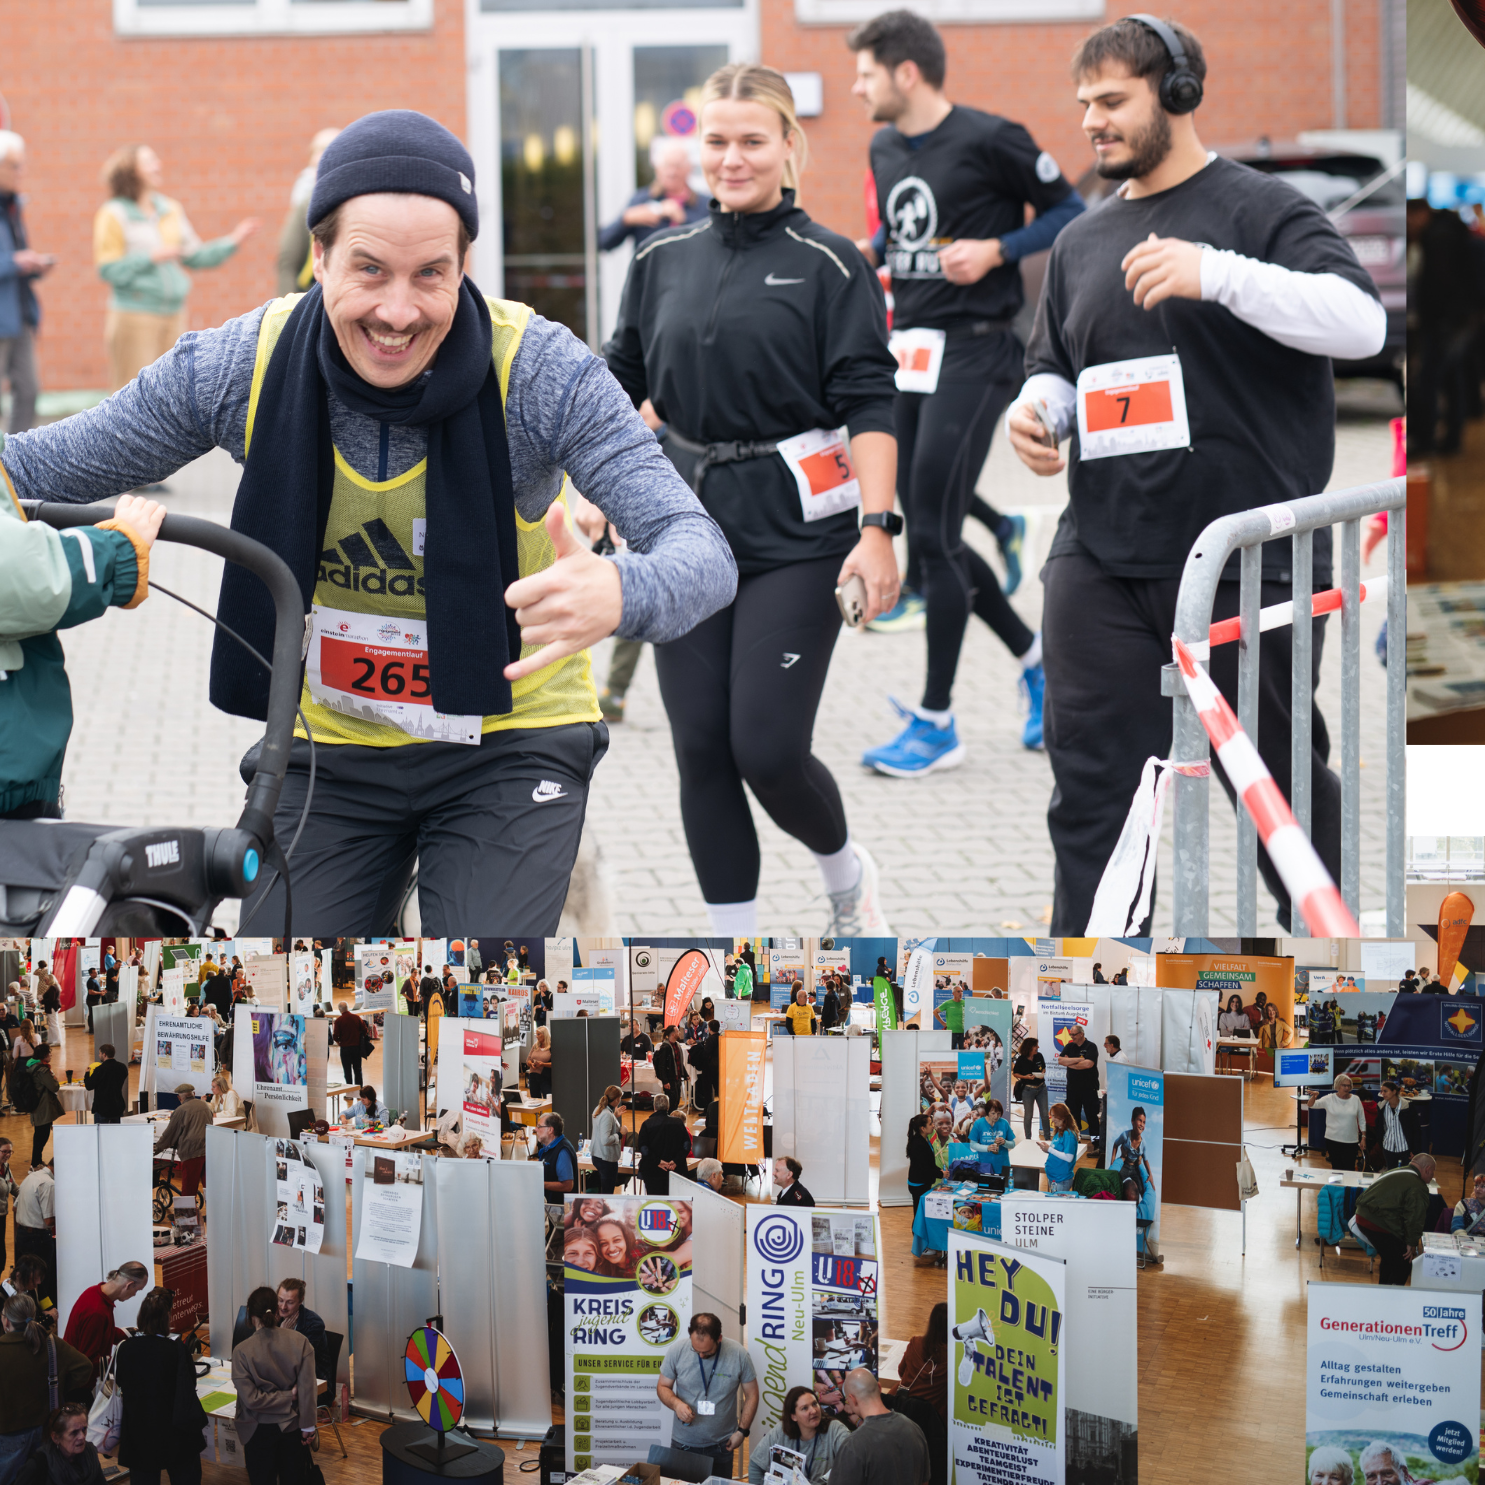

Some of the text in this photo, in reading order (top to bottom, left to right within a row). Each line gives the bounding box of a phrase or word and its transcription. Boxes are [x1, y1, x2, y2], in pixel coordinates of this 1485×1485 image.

[1116, 396, 1131, 424] 7
[834, 453, 850, 480] 5
[320, 628, 369, 642] einsteinmarathon
[364, 646, 424, 659] Engagementlauf
[351, 657, 433, 698] 265
[538, 780, 562, 794] NIKE
[145, 840, 180, 868] THULE
[911, 954, 923, 988] Lebenshilfe
[1213, 962, 1247, 971] VIELFALT
[673, 956, 700, 1001] Malteser
[1198, 981, 1239, 989] SCHAFFEN
[1203, 971, 1252, 981] GEMEINSAM
[508, 988, 529, 997] KAIROS
[1041, 1004, 1090, 1012] Notfallseelsorge
[158, 1020, 203, 1030] EHRENAMTLICHE
[1443, 1020, 1480, 1039] NOTFALLSEELSORGE
[157, 1031, 210, 1042] BEWÄHRUNGSHILFE
[256, 1083, 283, 1092] Ehrenamt
[1131, 1078, 1151, 1090] unicef
[264, 1092, 302, 1103] Persönlichkeit
[743, 1051, 762, 1150] WELTLADEN
[641, 1210, 667, 1230] U18
[1014, 1212, 1064, 1224] STOLPER
[984, 1225, 1002, 1237] unic
[1014, 1225, 1055, 1236] STEINE
[1015, 1237, 1038, 1248] ULM
[817, 1256, 855, 1287] U18
[955, 1249, 1024, 1292] HEY
[573, 1298, 634, 1316] KREIS
[791, 1270, 805, 1342] Neu-Ulm
[1424, 1306, 1465, 1319] 50 Jahre
[570, 1307, 633, 1336] jugend
[999, 1287, 1063, 1356] DU!
[1320, 1316, 1459, 1340] GenerationenTreff
[573, 1327, 626, 1345] RING
[1358, 1333, 1423, 1345] Ulm/Neu-Ulm e.V.
[578, 1358, 662, 1369] UNSER SERVICE FÜR EU
[995, 1343, 1036, 1371] DEIN
[972, 1350, 1053, 1403] TALENT
[1320, 1360, 1402, 1375] Alltag gestalten
[1320, 1374, 1451, 1394] Erfahrungen weitergeben
[996, 1384, 1025, 1407] IST
[1320, 1389, 1432, 1407] Gemeinschaft erleben
[967, 1394, 1048, 1440] GEFRAGT!
[1436, 1435, 1466, 1447] Mitglied
[1445, 1427, 1461, 1438] jetzt
[974, 1437, 1029, 1456] KREATIVITÄT
[1435, 1444, 1464, 1456] werden!
[967, 1445, 1039, 1467] ABENTEUERLUST
[979, 1455, 1028, 1473] TEAMGEIST
[955, 1458, 1055, 1485] EXPERIMENTIERFREUDE
